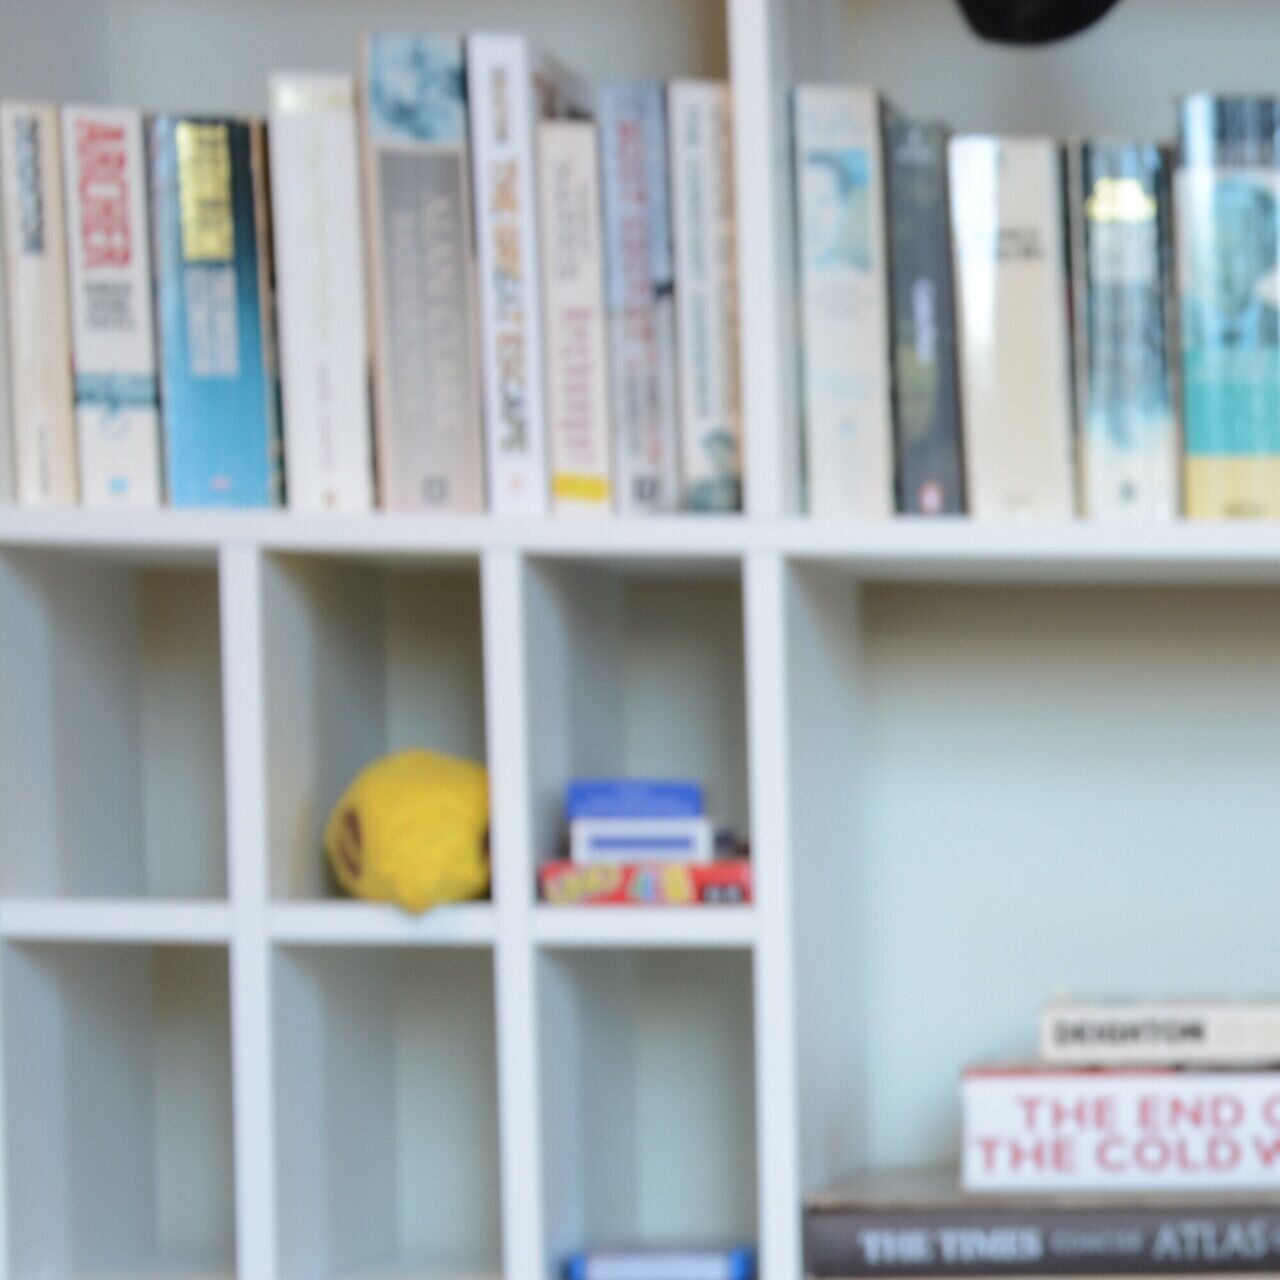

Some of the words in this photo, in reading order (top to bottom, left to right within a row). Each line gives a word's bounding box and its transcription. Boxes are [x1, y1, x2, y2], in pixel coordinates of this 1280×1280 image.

[74, 117, 132, 271] ARCHER
[489, 158, 520, 214] THE
[491, 223, 526, 328] GREAT
[497, 332, 529, 455] ESCAPE
[1018, 1095, 1116, 1132] THE
[1137, 1094, 1244, 1130] END
[973, 1138, 1075, 1175] THE
[1093, 1136, 1242, 1173] COLD
[859, 1231, 931, 1264] THE
[942, 1228, 1042, 1263] TIMES
[1153, 1220, 1267, 1260] ATLAS
